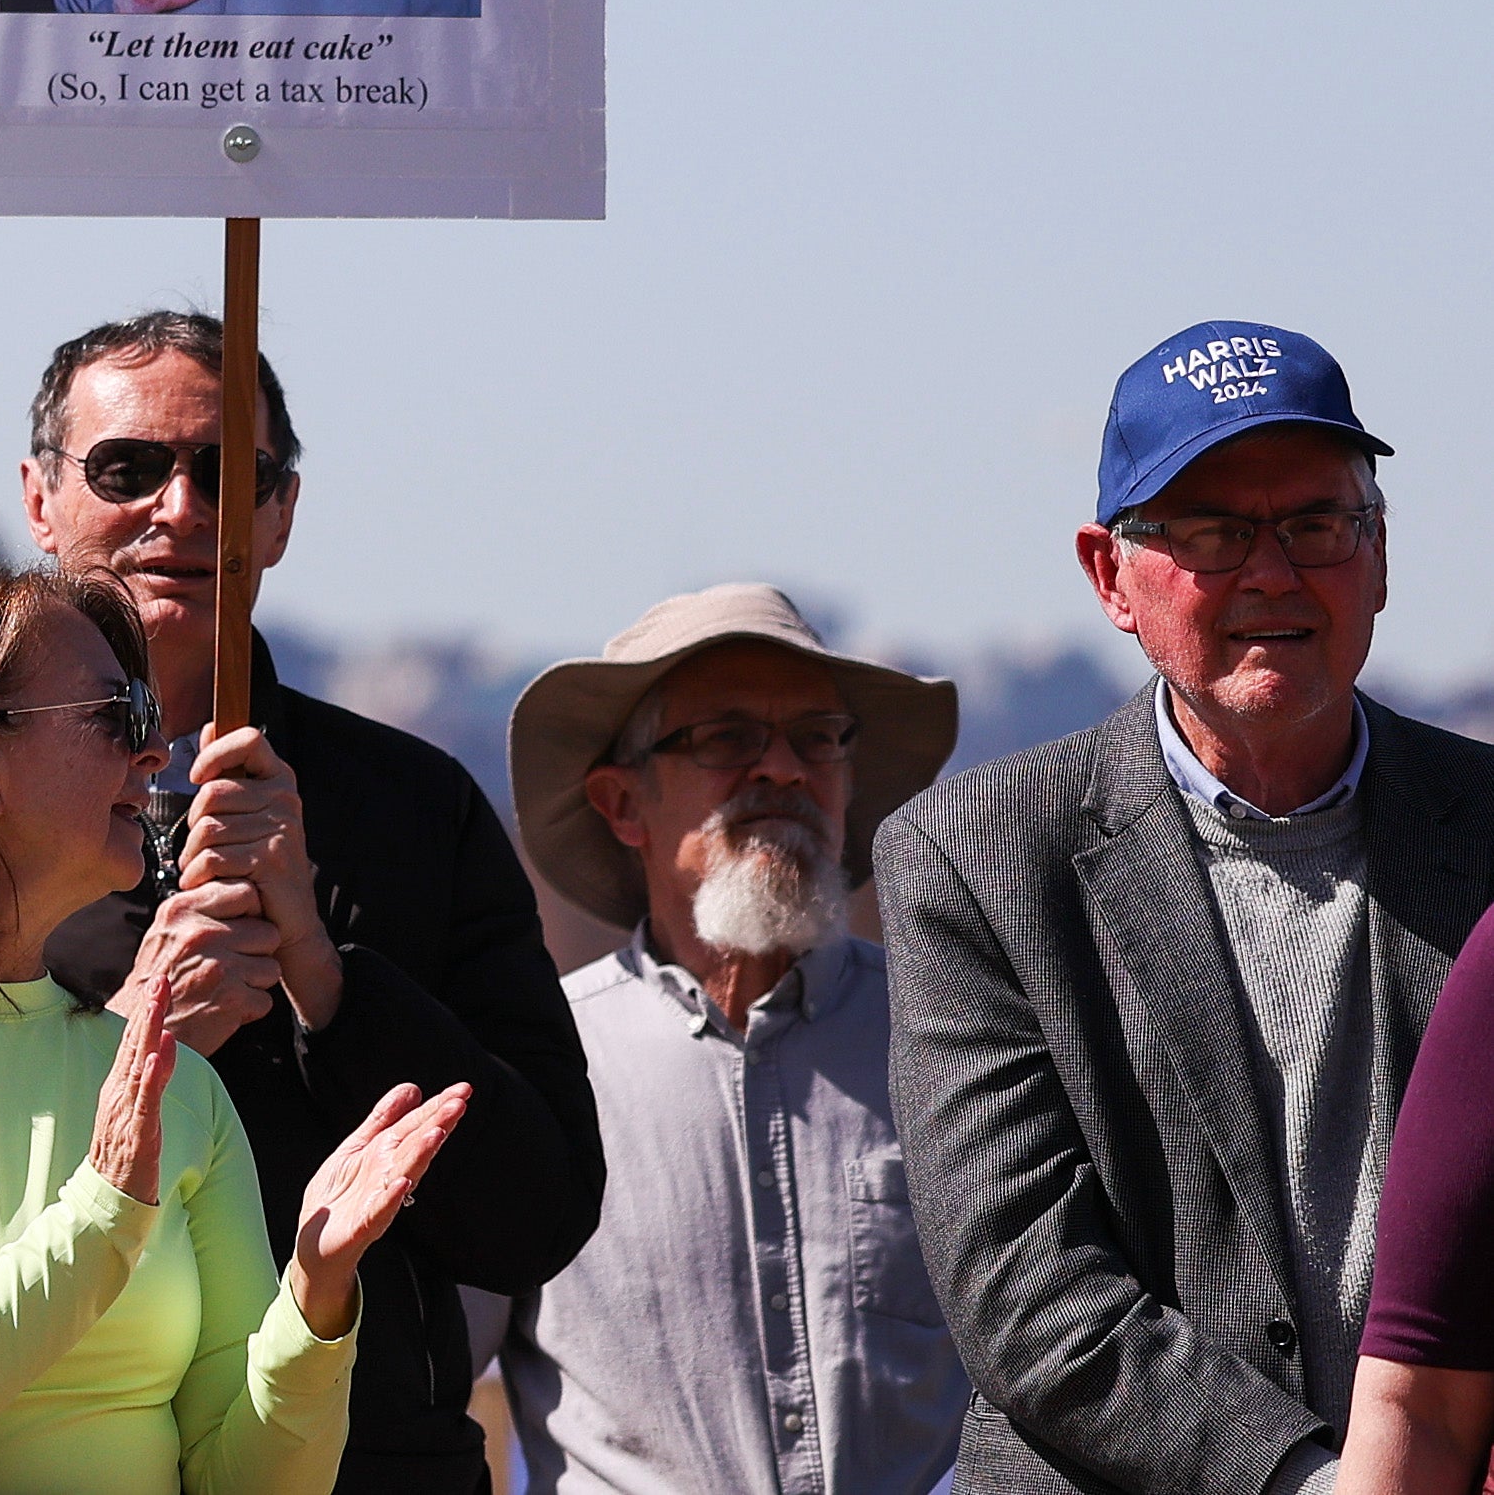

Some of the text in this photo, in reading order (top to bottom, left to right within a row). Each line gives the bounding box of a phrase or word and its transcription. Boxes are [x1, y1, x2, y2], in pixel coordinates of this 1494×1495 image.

[89, 31, 393, 60] “Let them eat cake”
[47, 73, 428, 111] (So, I can get a tax break)
[1163, 337, 1281, 383] HARRIS
[1189, 359, 1276, 390] WALZ
[1212, 381, 1267, 404] 2024
